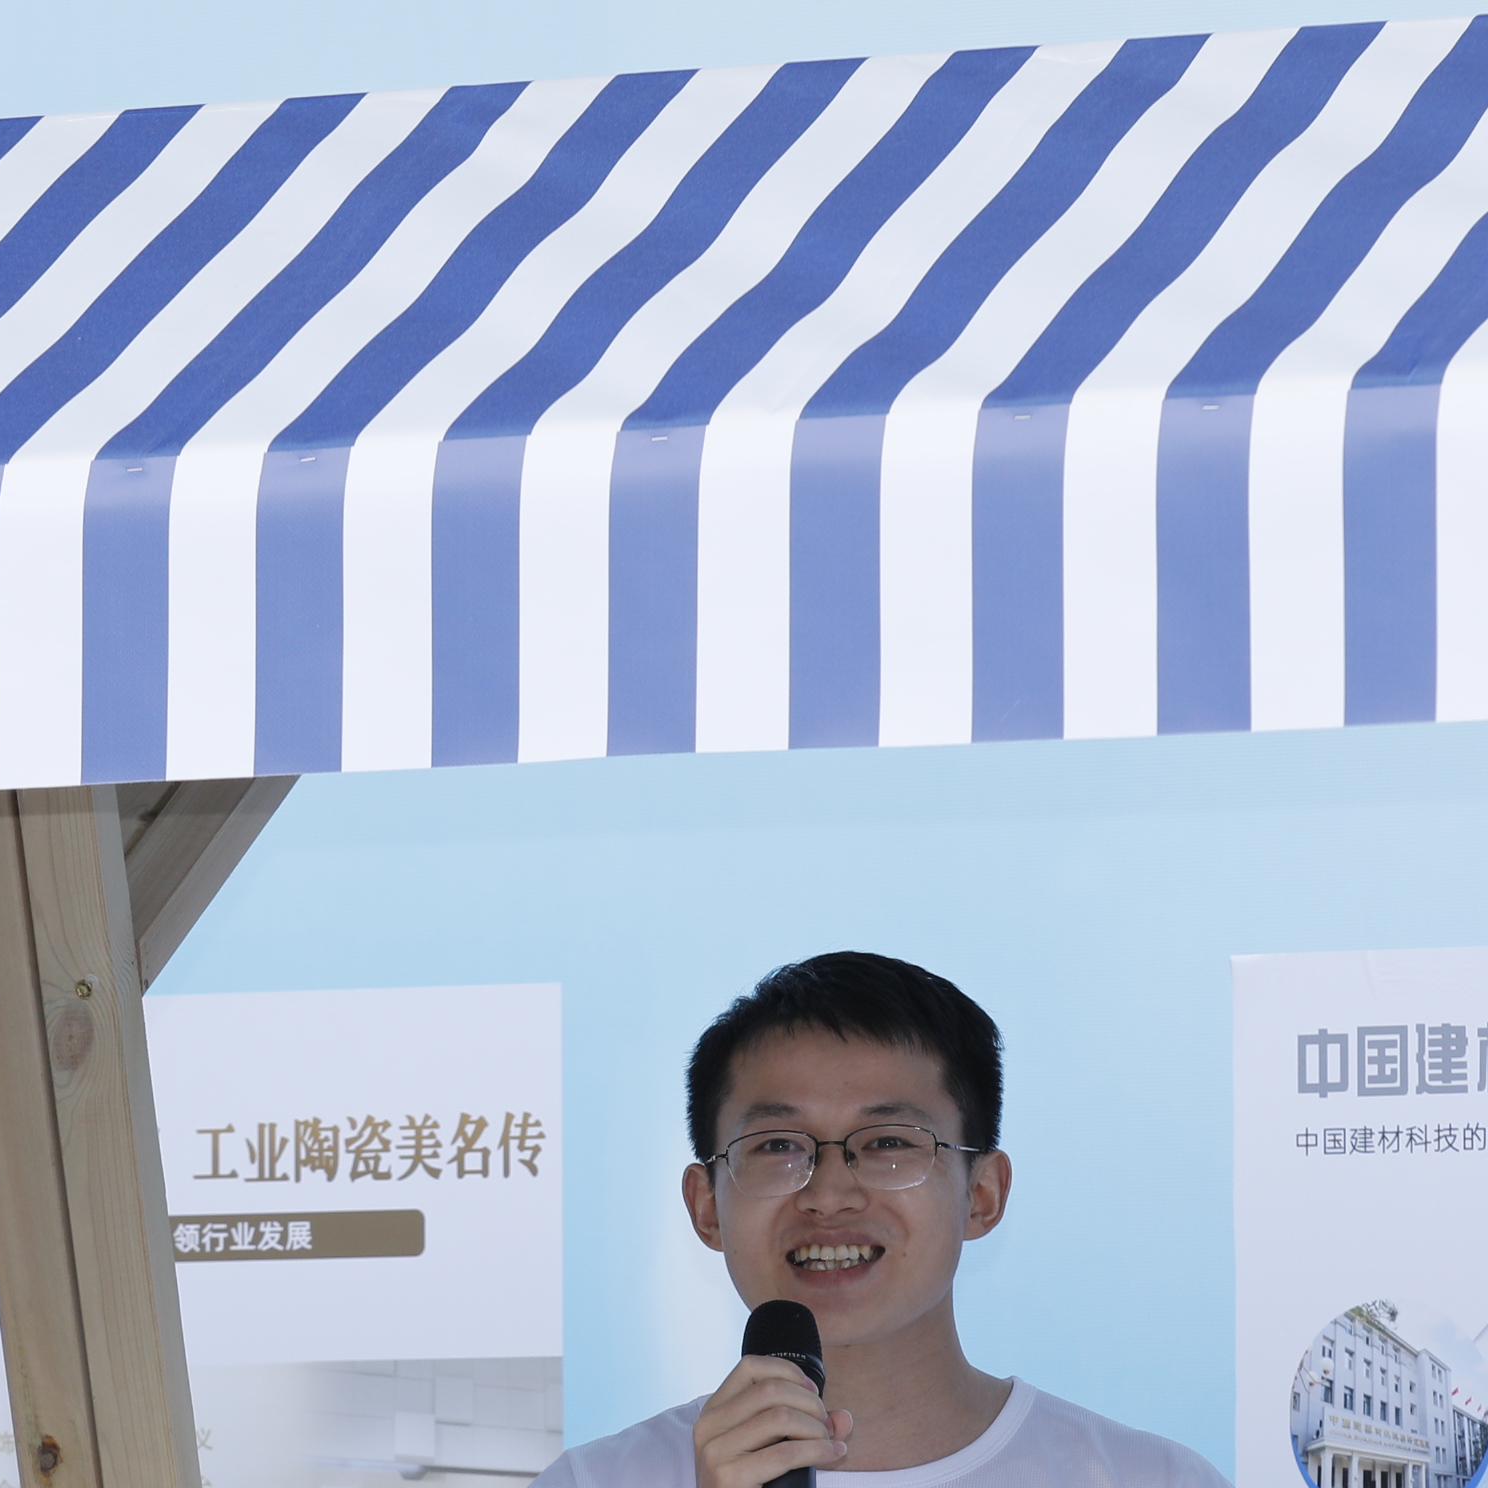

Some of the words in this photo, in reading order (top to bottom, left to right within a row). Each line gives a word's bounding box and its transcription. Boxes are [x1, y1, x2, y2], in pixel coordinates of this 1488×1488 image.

[192, 1110, 547, 1185] 工业陶瓷美名传
[172, 1220, 313, 1253] 领行业发展
